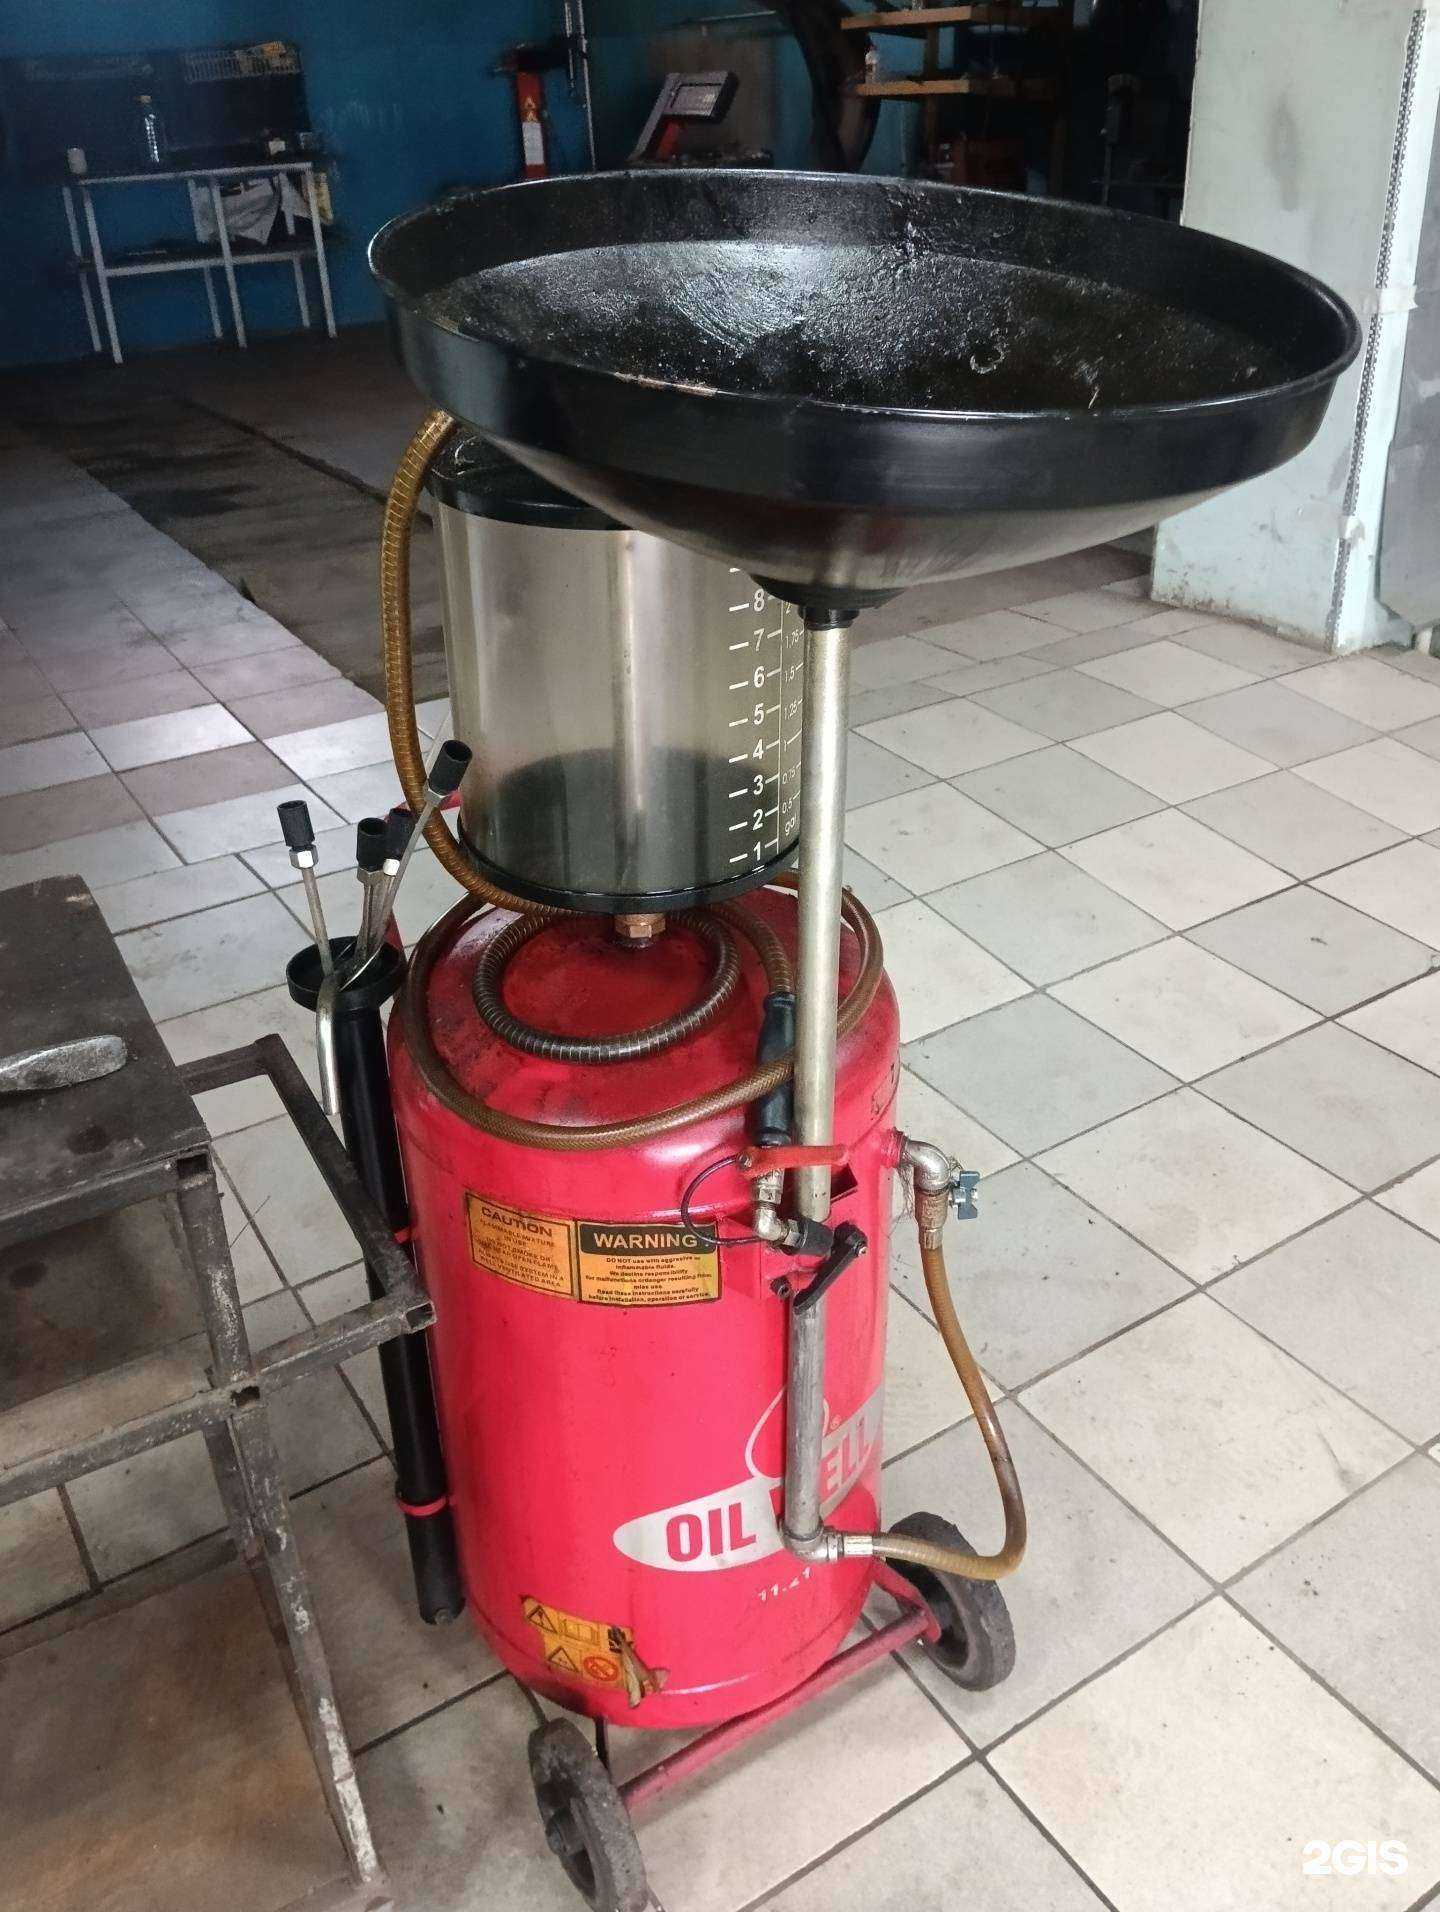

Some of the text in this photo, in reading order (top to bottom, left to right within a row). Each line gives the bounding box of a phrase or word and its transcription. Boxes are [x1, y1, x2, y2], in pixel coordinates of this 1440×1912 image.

[753, 588, 765, 612] 8
[754, 628, 765, 652] 7
[753, 666, 765, 688] 6
[753, 703, 765, 725] 5
[752, 739, 764, 760] 4
[753, 774, 764, 795] 3
[752, 809, 764, 831] 2
[753, 841, 761, 861] 1
[481, 1206, 552, 1238] CAUTION
[593, 1232, 697, 1248] WARNING
[666, 1502, 756, 1563] OIL
